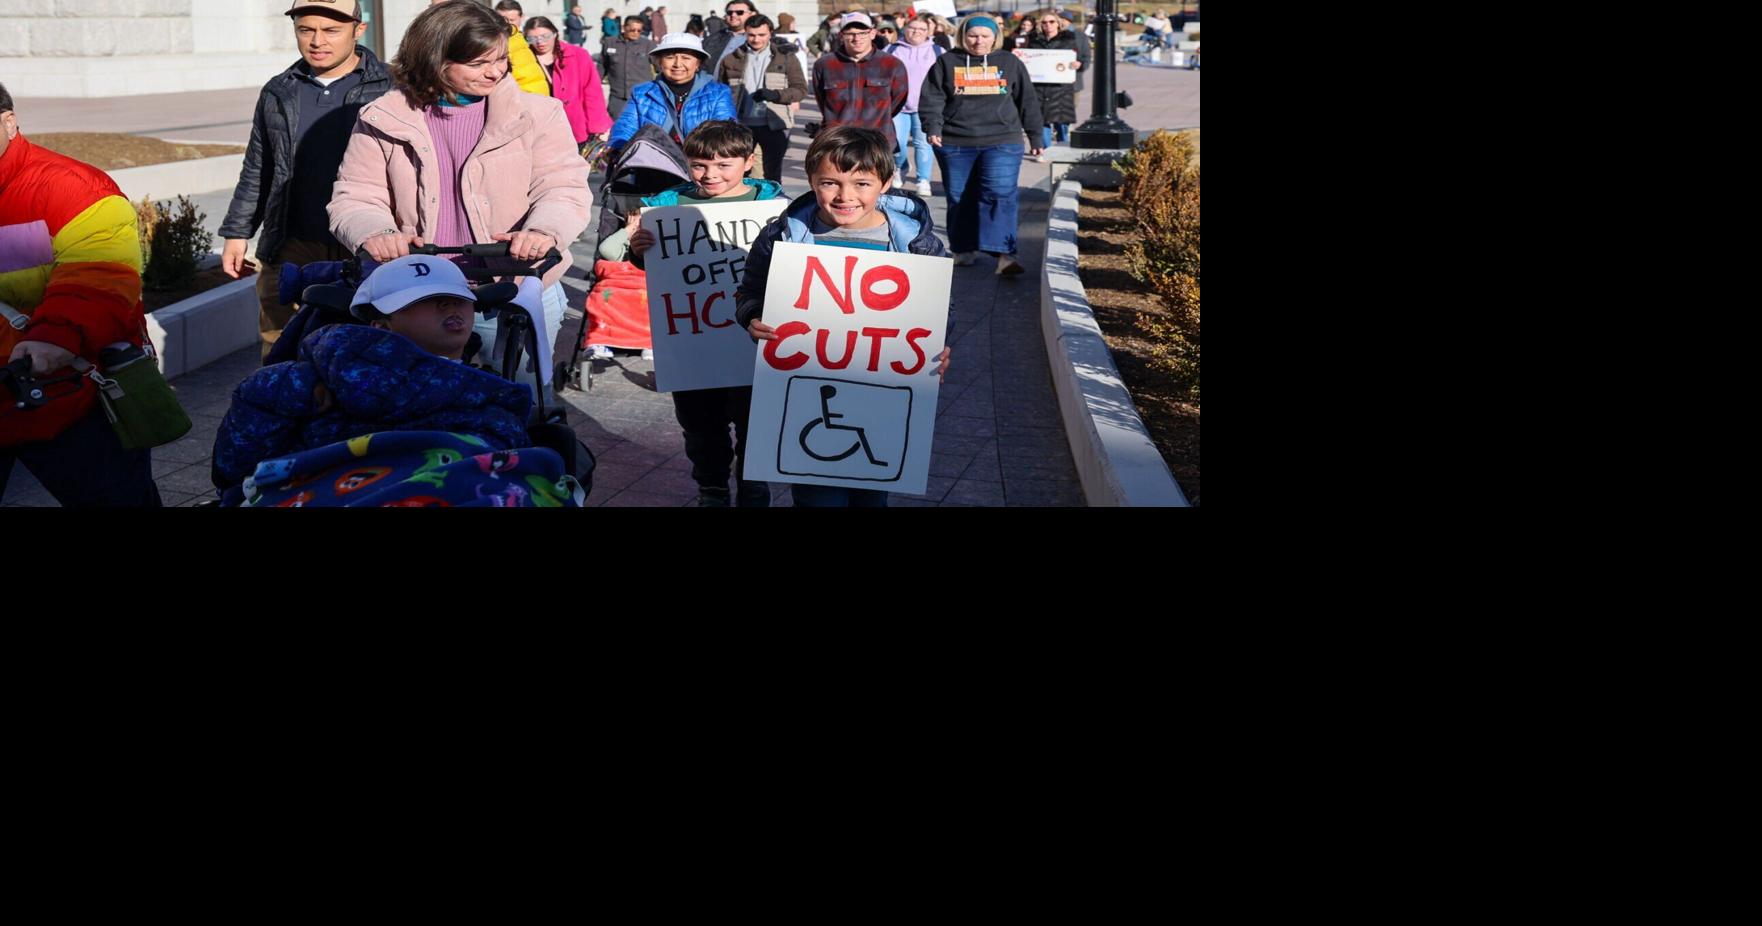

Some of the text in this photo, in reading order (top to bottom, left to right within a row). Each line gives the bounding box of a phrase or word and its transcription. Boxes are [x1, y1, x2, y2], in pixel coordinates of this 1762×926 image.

[656, 215, 781, 259] HAND
[408, 263, 430, 277] D
[682, 256, 746, 285] OFF
[793, 256, 910, 314] NO
[661, 291, 741, 335] HC
[763, 321, 932, 375] CUTS
